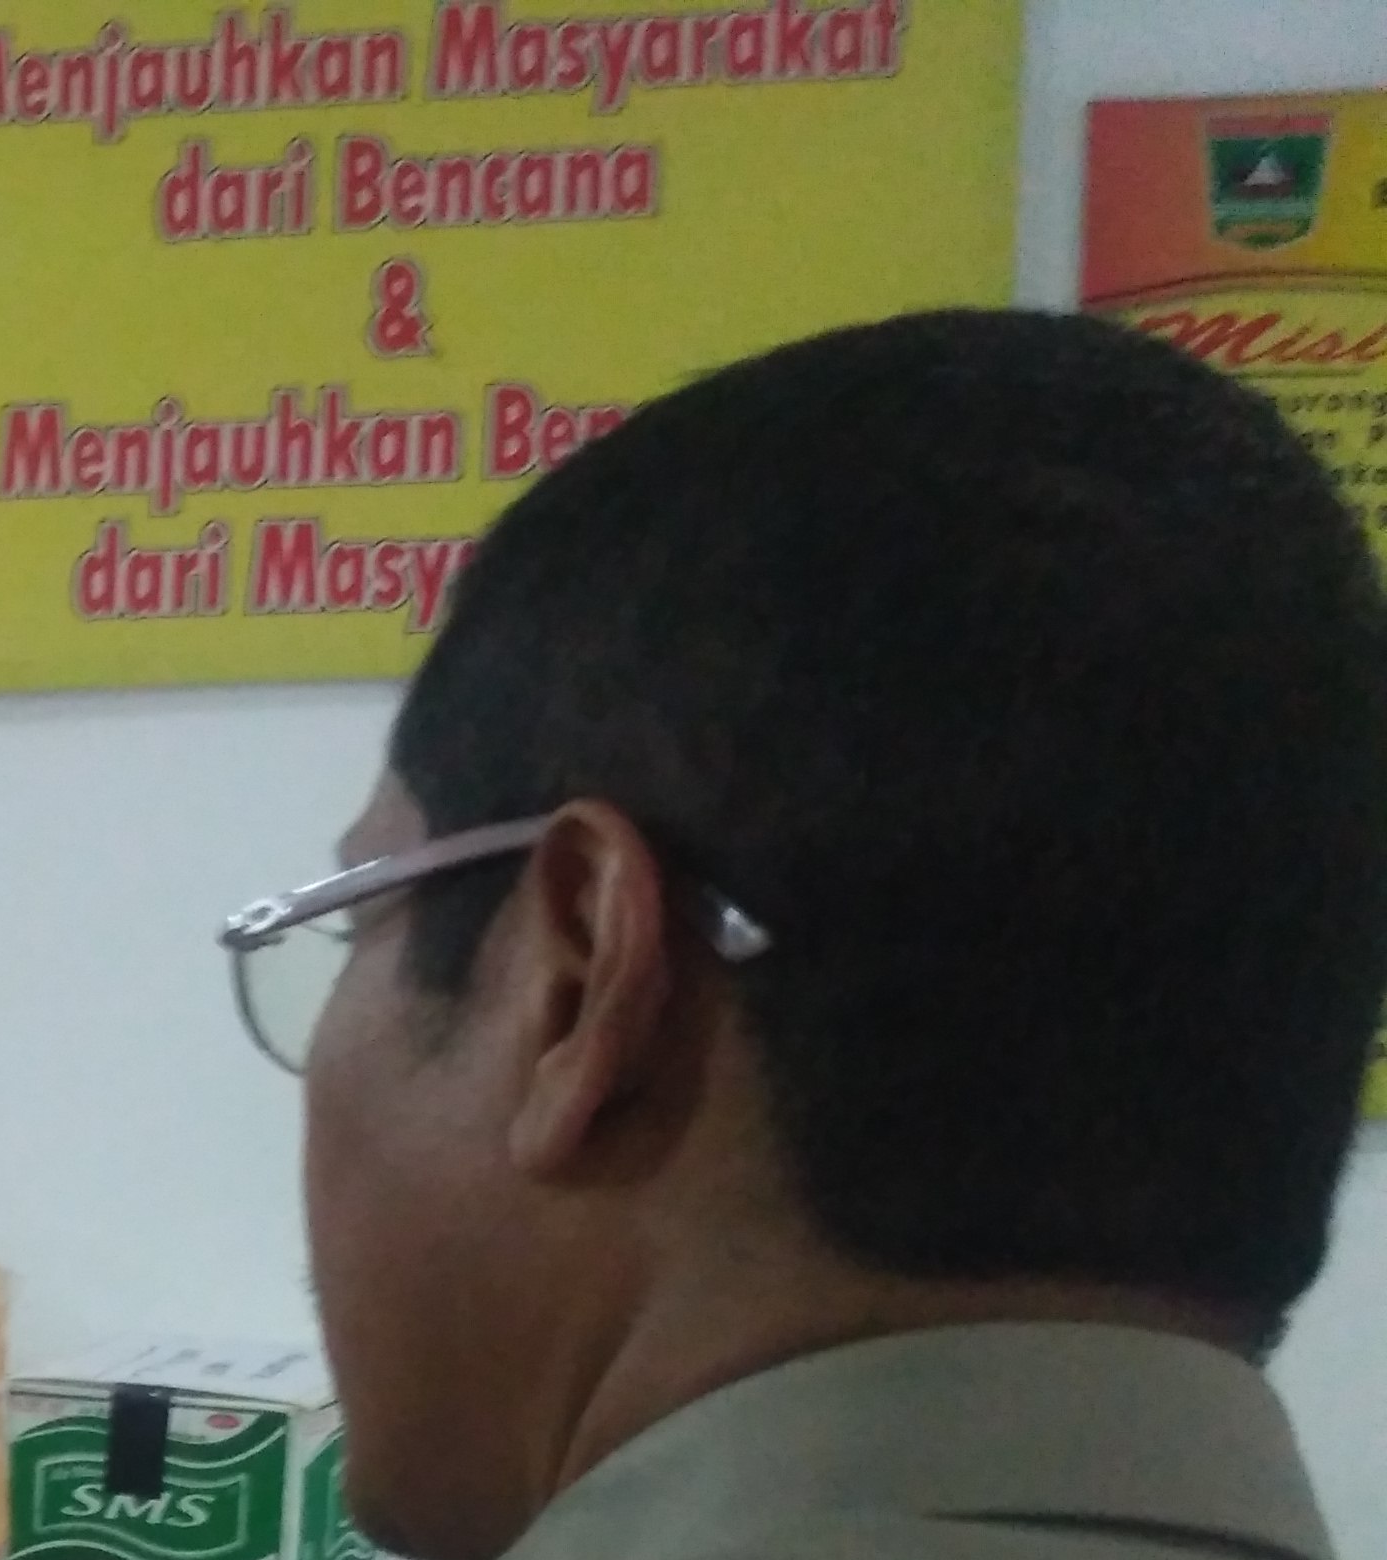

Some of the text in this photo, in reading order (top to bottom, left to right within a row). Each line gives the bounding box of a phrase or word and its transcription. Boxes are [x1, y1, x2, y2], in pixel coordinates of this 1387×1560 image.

[434, 0, 905, 115] Masyarakat
[158, 133, 658, 242] dari Bencana
[369, 256, 434, 360] &
[74, 518, 227, 620] dari
[60, 1481, 215, 1529] SMS
